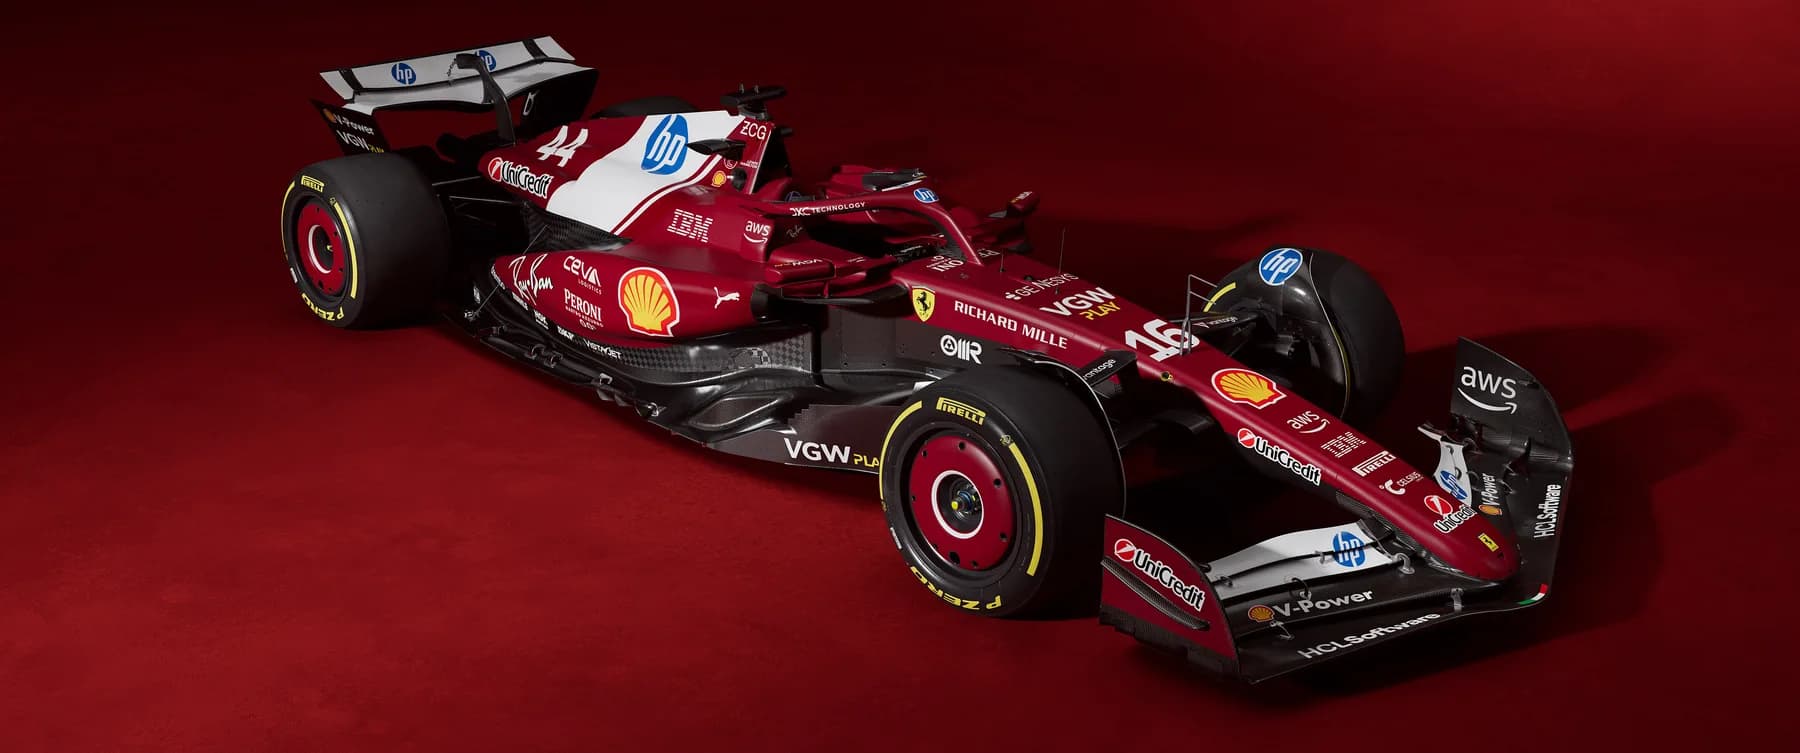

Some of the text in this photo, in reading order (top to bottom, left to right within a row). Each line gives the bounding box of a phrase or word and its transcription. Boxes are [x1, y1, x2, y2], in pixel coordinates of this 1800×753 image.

[393, 62, 415, 85] hp
[336, 130, 370, 151] VGW
[536, 125, 589, 167] 44
[642, 113, 687, 175] hp
[502, 161, 553, 199] UniCredit
[812, 202, 866, 214] TECHNOLOGY
[667, 209, 713, 243] IBM
[745, 220, 771, 237] aws
[1260, 248, 1302, 285] hp
[1015, 273, 1080, 296] GENESYS
[564, 287, 602, 322] PERONI
[1040, 287, 1117, 317] VGW
[1080, 302, 1121, 320] PLAY
[955, 300, 1068, 350] RICHARD MILLE
[1125, 318, 1200, 362] 16
[1461, 365, 1517, 399] aws
[936, 397, 986, 425] PIRELLI
[1287, 411, 1320, 430] aws
[784, 437, 880, 468] VGW PLA
[1254, 435, 1322, 486] UniCredit
[1320, 431, 1367, 458] IBM
[1352, 450, 1397, 477] PIRELLI
[1481, 473, 1500, 506] V-Power
[1433, 504, 1478, 534] UniCredit
[1533, 484, 1561, 538] HCLSoftware
[1335, 531, 1365, 567] hp
[910, 566, 1002, 611] P ZERO
[1133, 548, 1205, 611] UniCredit
[1276, 588, 1374, 618] V-Power
[1297, 611, 1442, 660] HCLSoftware
